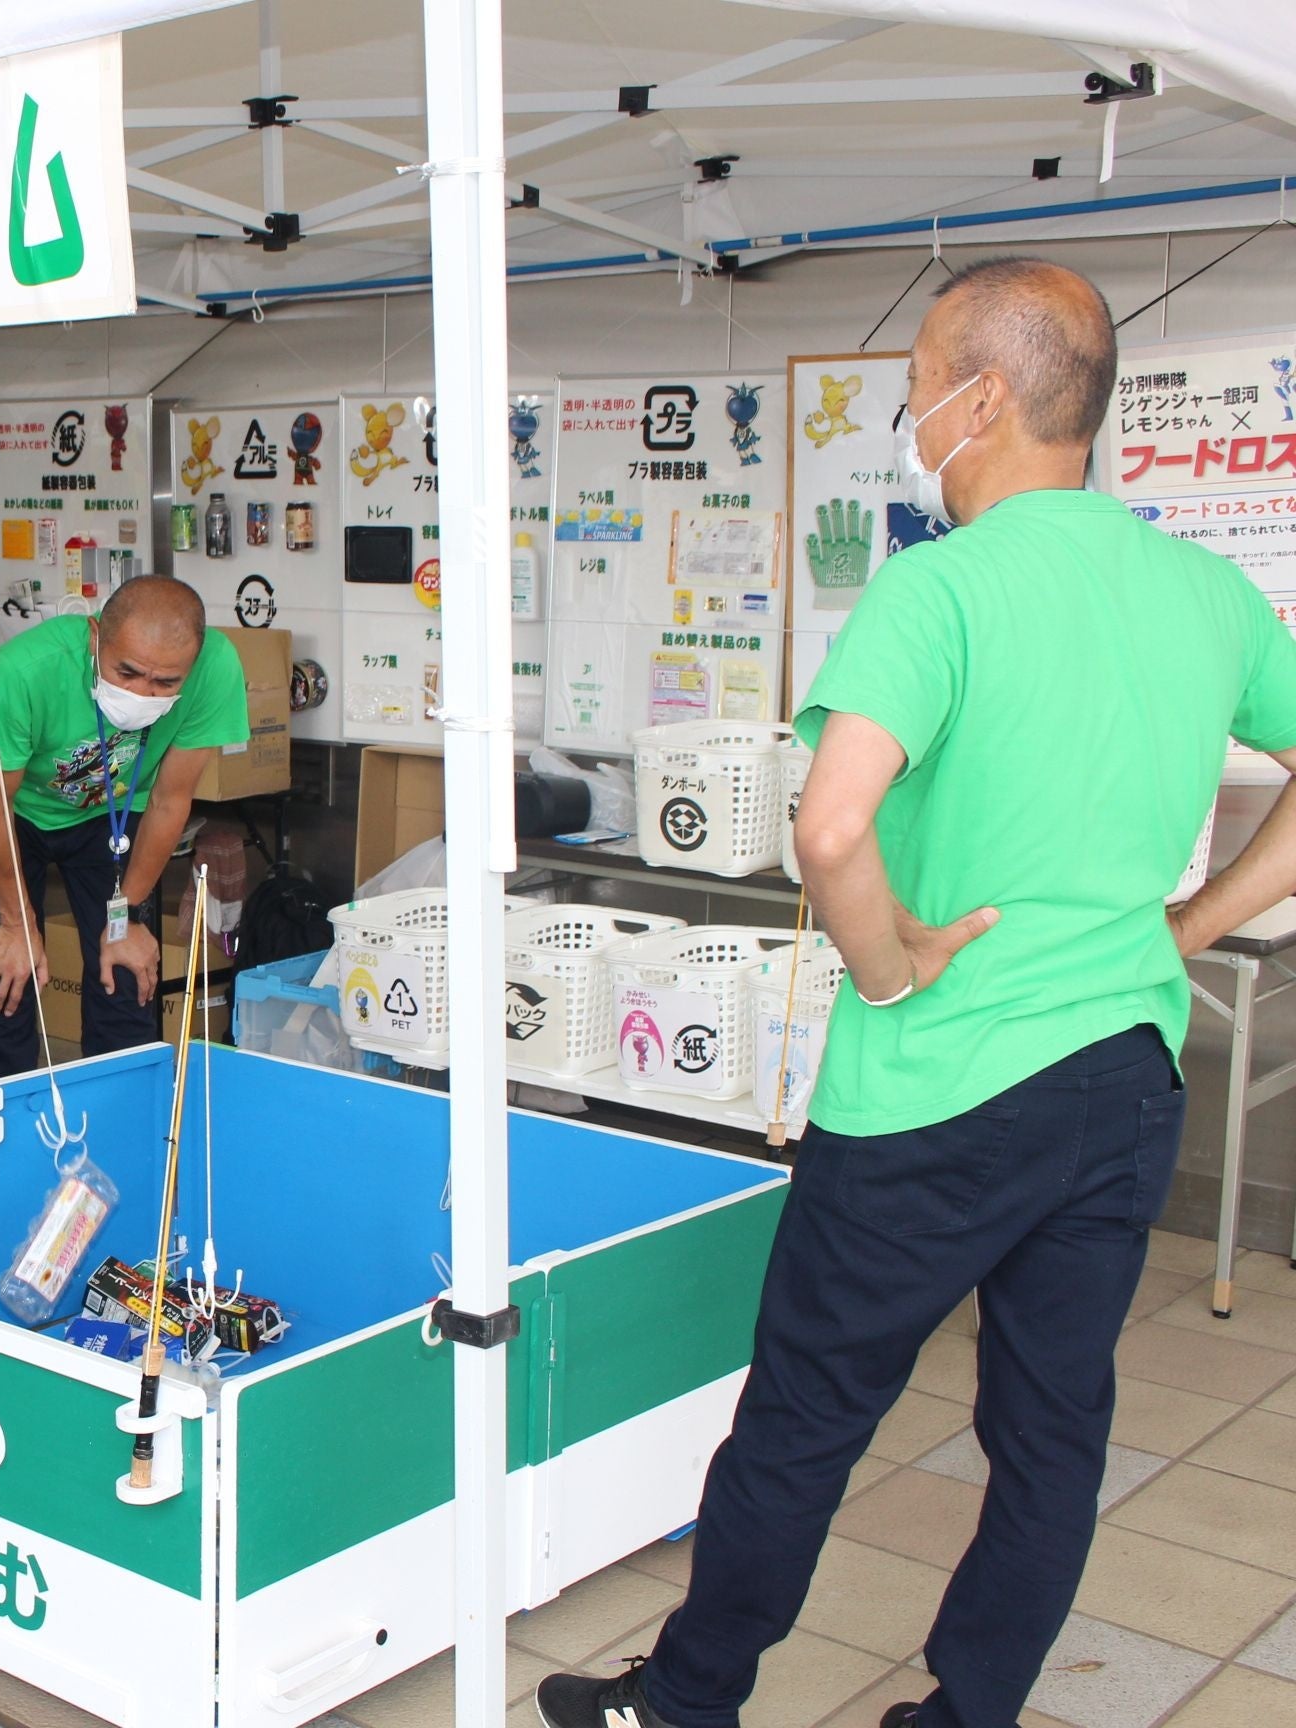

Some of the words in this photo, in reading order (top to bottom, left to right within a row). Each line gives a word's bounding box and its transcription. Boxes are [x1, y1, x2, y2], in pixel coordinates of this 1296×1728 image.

[1118, 371, 1187, 395] 分別戦隊
[563, 398, 636, 412] 透明・半透明の
[1119, 386, 1259, 414] シゲンジャー銀河
[562, 417, 638, 432] 袋に入れて出す
[655, 401, 693, 435] プラ
[1121, 415, 1212, 435] レモンちゃん
[59, 425, 77, 452] 紙
[250, 445, 277, 470] アルミ
[1121, 433, 1296, 483] フードロス
[628, 461, 708, 481] プラ製容器包装
[850, 469, 901, 485] ペットボ
[413, 475, 438, 493] プラ
[578, 490, 615, 505] ラベル類
[702, 494, 751, 509] お菓子の袋
[366, 505, 394, 520] トレイ
[593, 530, 633, 541] SPARKLING
[580, 557, 607, 574] レジ袋
[662, 631, 761, 651] 詰め替え製品の袋
[363, 655, 398, 669] ラップ類
[661, 775, 707, 793] ダンボール
[392, 1018, 411, 1031] PET
[768, 1019, 809, 1039] ぷらちっく
[683, 1035, 707, 1062] 紙
